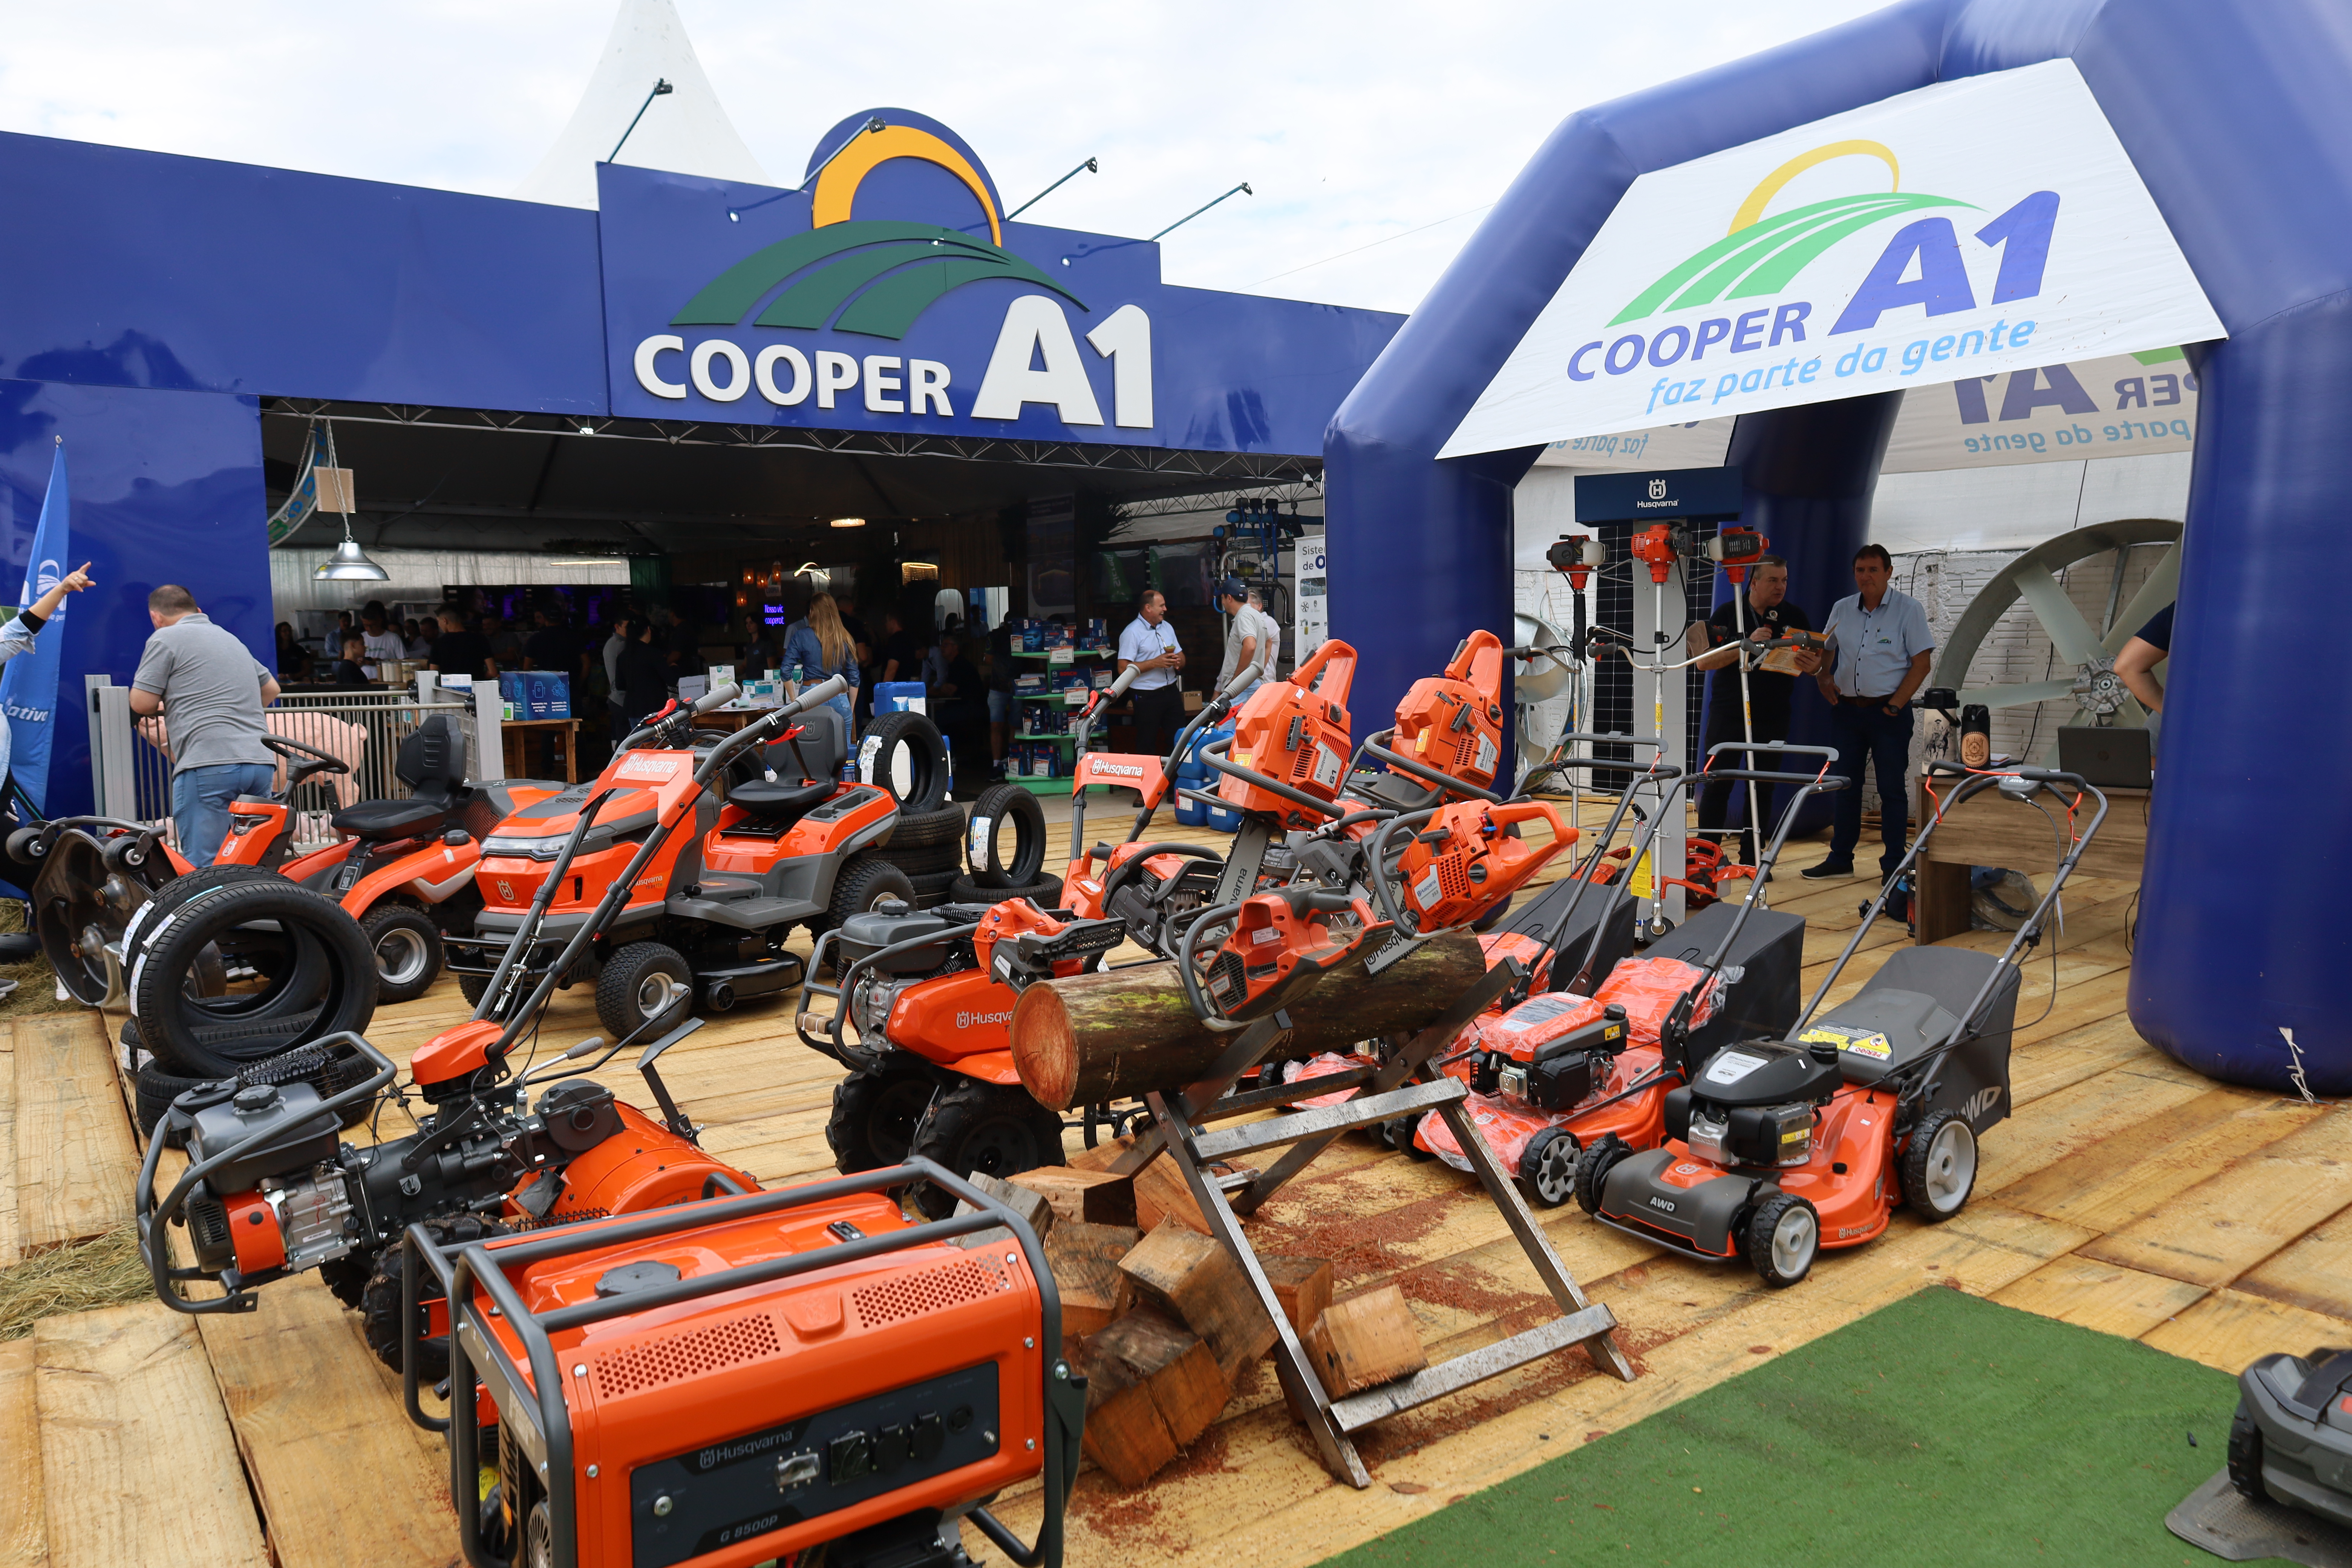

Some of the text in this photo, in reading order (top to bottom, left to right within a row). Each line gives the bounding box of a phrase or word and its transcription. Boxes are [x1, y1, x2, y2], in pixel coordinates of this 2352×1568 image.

[1567, 190, 2061, 381] COOPER A1
[634, 295, 1154, 429] COOPER A1
[1645, 320, 2036, 415] faz parte da gente
[1302, 545, 1325, 555] Siste
[1303, 561, 1314, 570] de
[634, 756, 678, 774] Husqvarna
[1100, 760, 1143, 776] Husqvarna
[1319, 749, 1328, 774] Husqvarna
[1329, 769, 1337, 784] 61
[1420, 879, 1436, 894] Husqvarna
[971, 1011, 1013, 1024] Husqva
[1855, 1047, 1882, 1057] PERIGO
[1649, 1196, 1675, 1212] AWD
[1847, 1222, 1874, 1237] Husqvarna
[717, 1430, 793, 1463] Husqvarna
[720, 1515, 778, 1543] G 8500P
